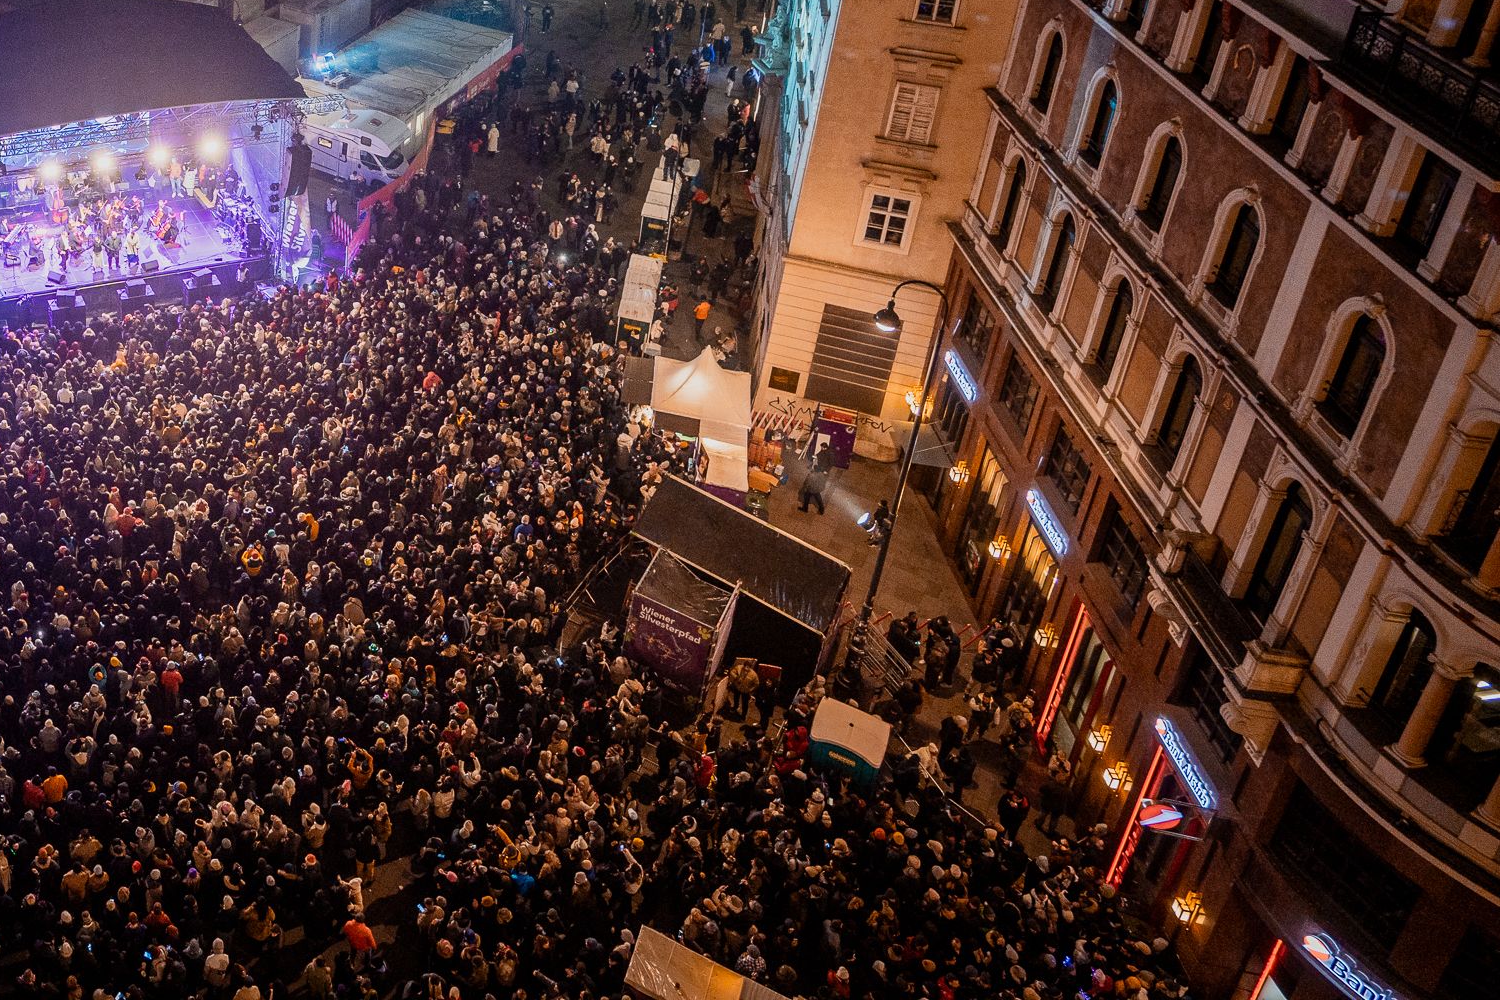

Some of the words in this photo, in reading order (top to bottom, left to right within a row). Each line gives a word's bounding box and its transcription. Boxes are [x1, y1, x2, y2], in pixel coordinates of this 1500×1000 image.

[282, 200, 298, 248] Wiener
[639, 611, 702, 645] Silvesterpfad
[640, 604, 676, 625] Wiener
[1164, 730, 1187, 767] Bank
[1181, 762, 1211, 808] Austria
